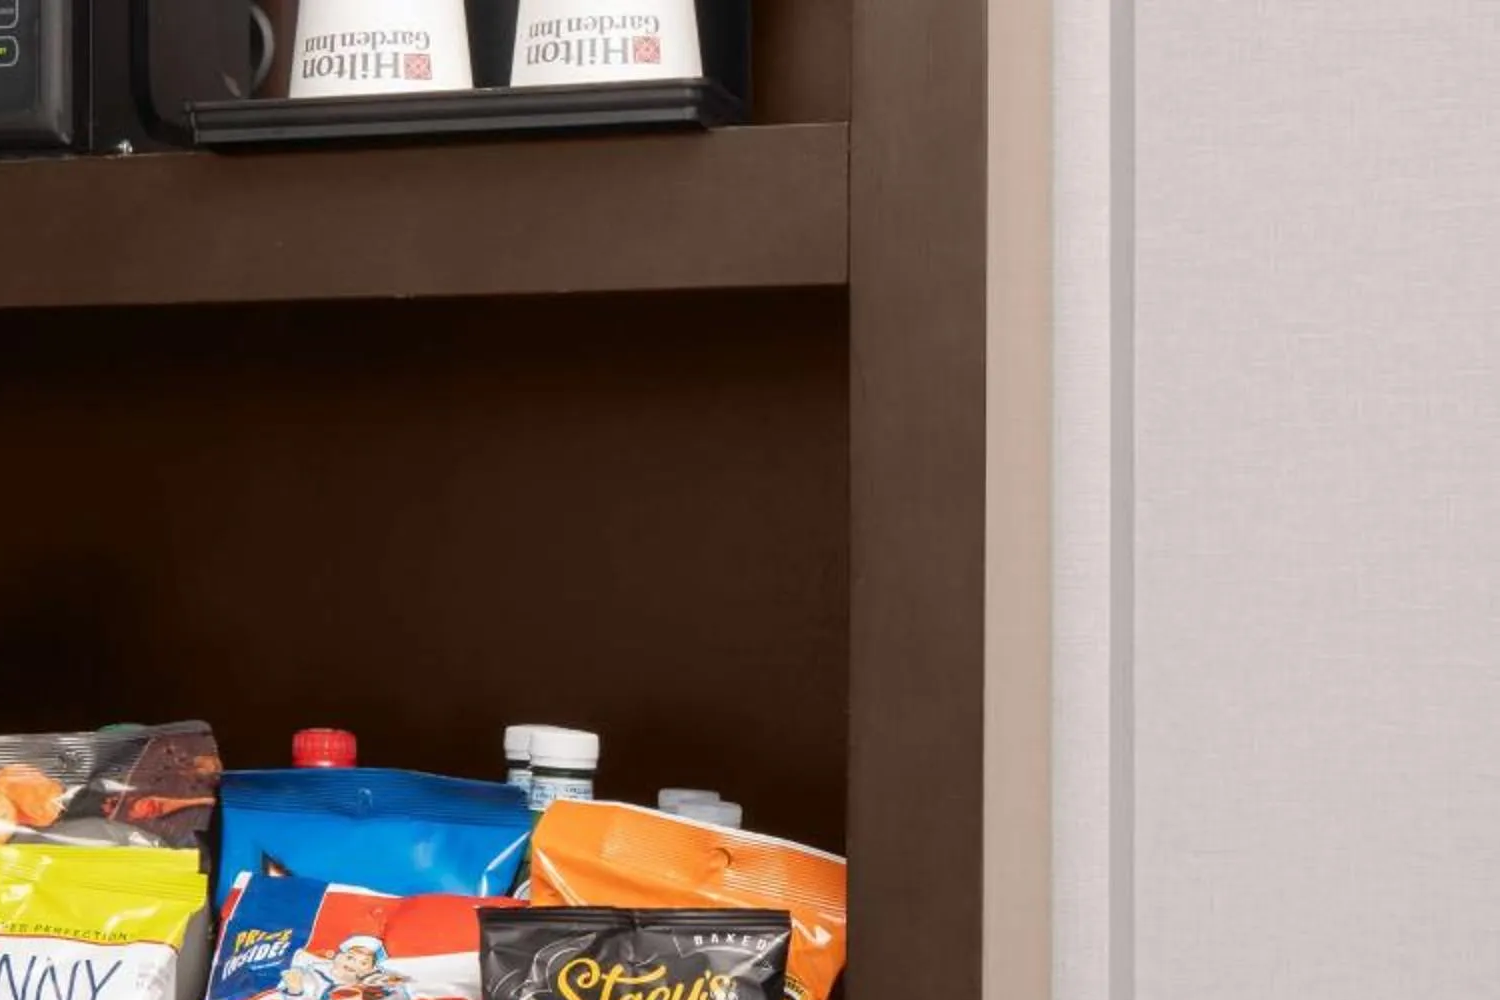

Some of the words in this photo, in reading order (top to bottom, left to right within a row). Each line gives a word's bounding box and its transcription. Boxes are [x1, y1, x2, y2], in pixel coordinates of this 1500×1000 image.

[528, 19, 561, 39] Inn
[567, 15, 660, 35] Garden
[304, 33, 335, 53] Inn
[341, 30, 431, 51] Garden
[526, 37, 629, 66] Hilton
[302, 51, 399, 80] Hilton
